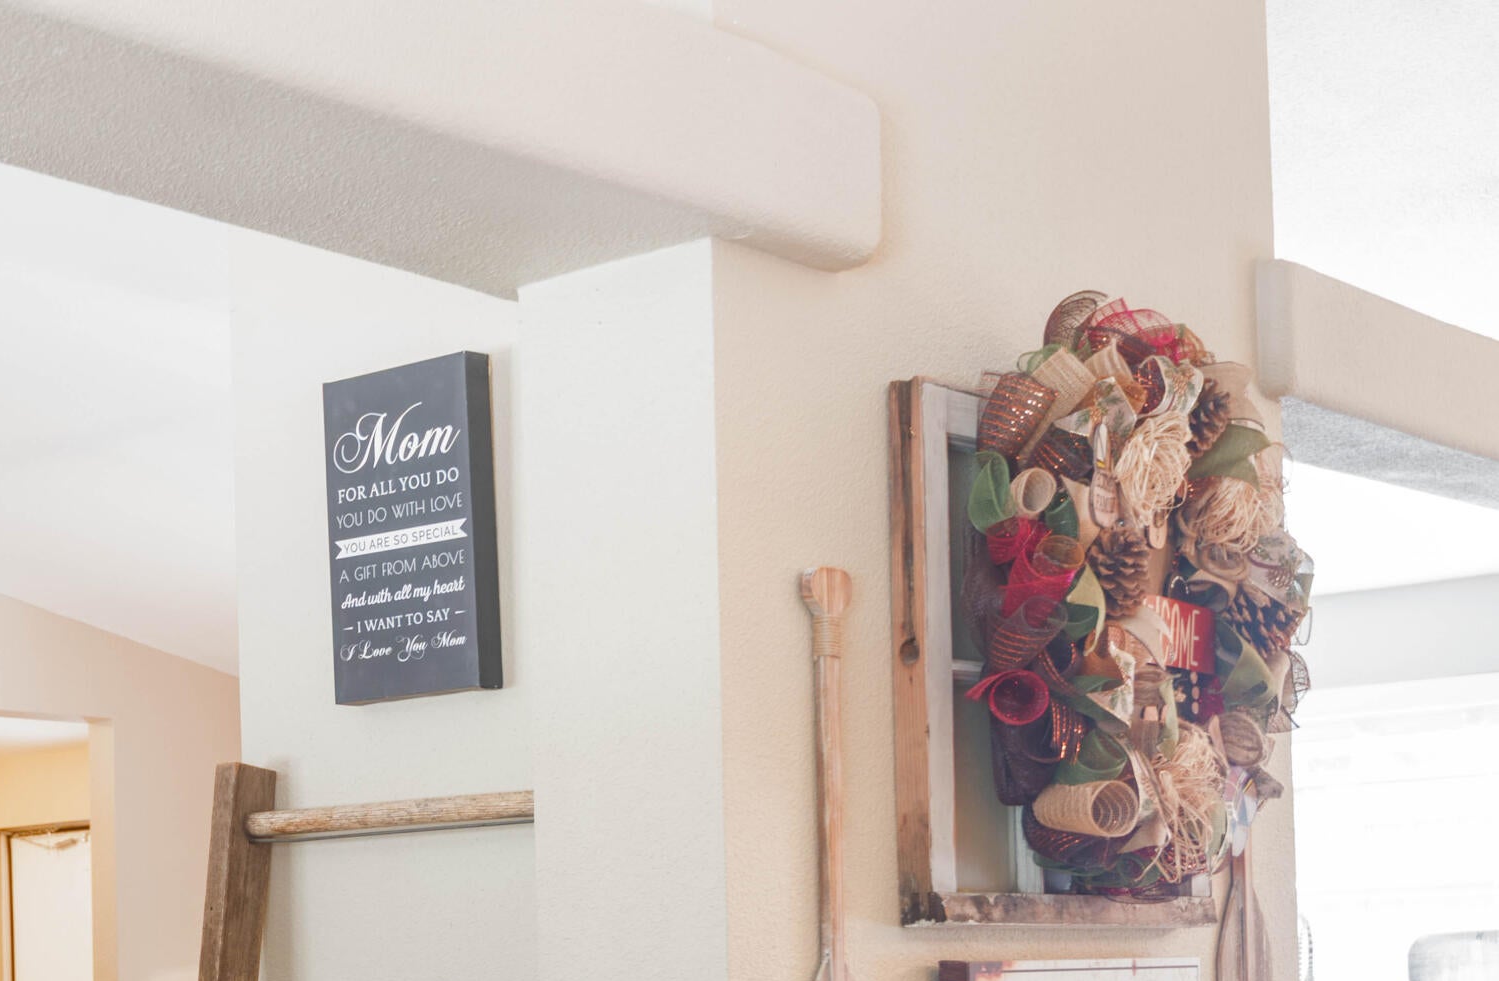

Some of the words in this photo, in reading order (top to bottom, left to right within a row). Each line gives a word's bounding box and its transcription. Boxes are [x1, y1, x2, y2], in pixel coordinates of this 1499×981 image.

[334, 402, 460, 474] Mom
[337, 483, 366, 504] FOR
[369, 479, 396, 498] ALL
[399, 472, 430, 494] YOU
[437, 466, 459, 485] DO
[336, 510, 363, 529] YOU
[368, 506, 387, 523] DO
[391, 499, 425, 519] WITH
[431, 492, 462, 513] LOVE
[344, 541, 365, 554] YOU
[369, 537, 389, 551] ARE
[394, 533, 408, 545] SO
[413, 525, 457, 543] SPECIAL
[340, 568, 349, 583] A
[354, 563, 376, 582] GIFT
[382, 557, 416, 577] FROM
[422, 550, 465, 570] ABOVE
[341, 590, 365, 609] And
[366, 588, 392, 607] with
[394, 585, 413, 600] all
[413, 585, 431, 602] my
[433, 576, 465, 597] heart
[357, 622, 361, 633] I
[365, 614, 403, 633] WANT
[405, 613, 423, 626] TO
[426, 608, 450, 625] SAY
[340, 642, 357, 662] I
[358, 639, 392, 661] Love
[398, 633, 427, 662] You
[431, 630, 466, 649] Mom
